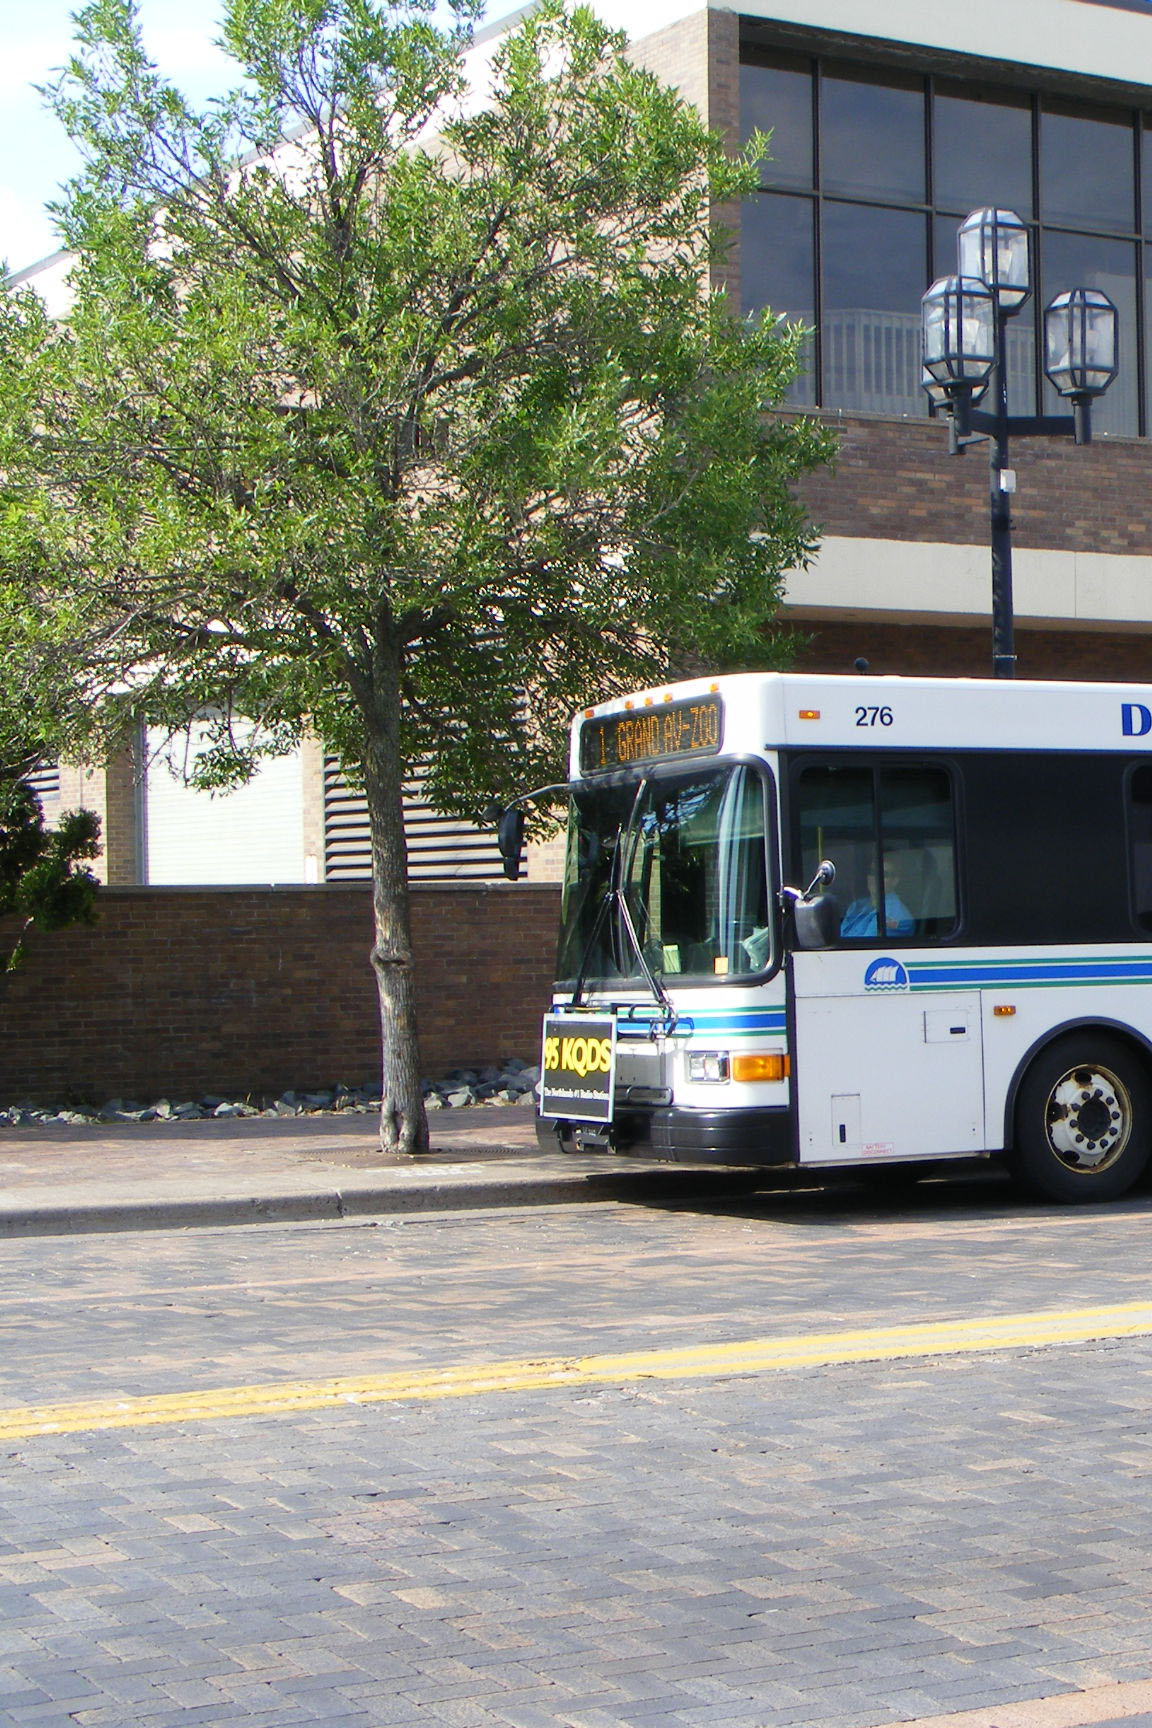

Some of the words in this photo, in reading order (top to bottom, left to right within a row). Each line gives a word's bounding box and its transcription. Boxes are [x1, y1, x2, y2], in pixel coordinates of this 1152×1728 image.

[617, 715, 659, 760] GRAND
[855, 706, 894, 727] 276
[561, 1036, 612, 1078] KQDS
